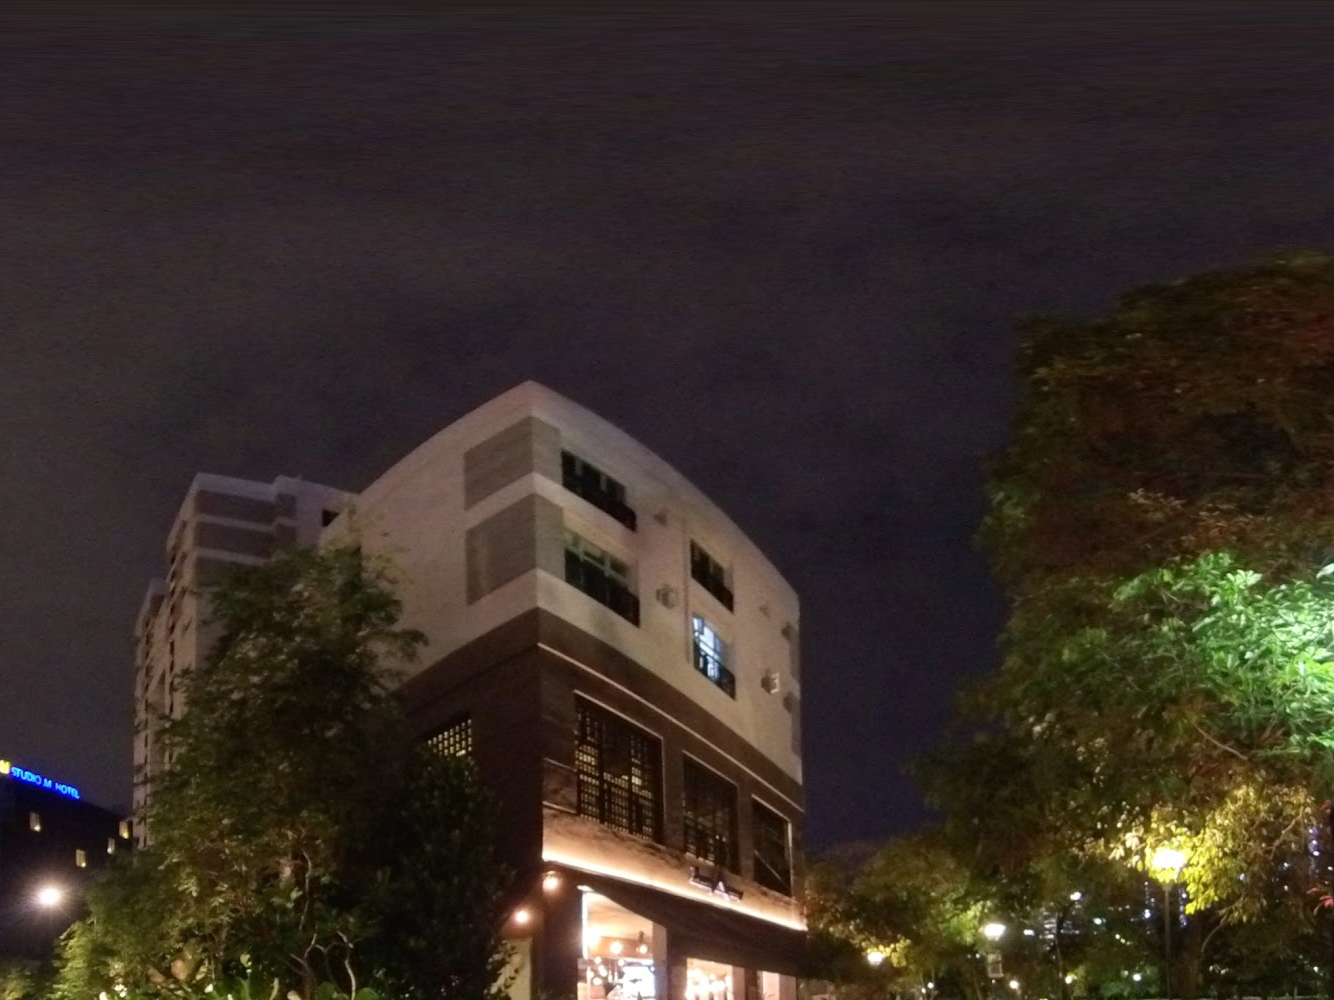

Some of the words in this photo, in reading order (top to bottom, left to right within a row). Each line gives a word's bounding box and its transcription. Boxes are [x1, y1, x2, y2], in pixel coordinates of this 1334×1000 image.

[11, 767, 42, 785] STUDIO
[43, 778, 52, 788] M
[55, 782, 80, 799] HOTEL
